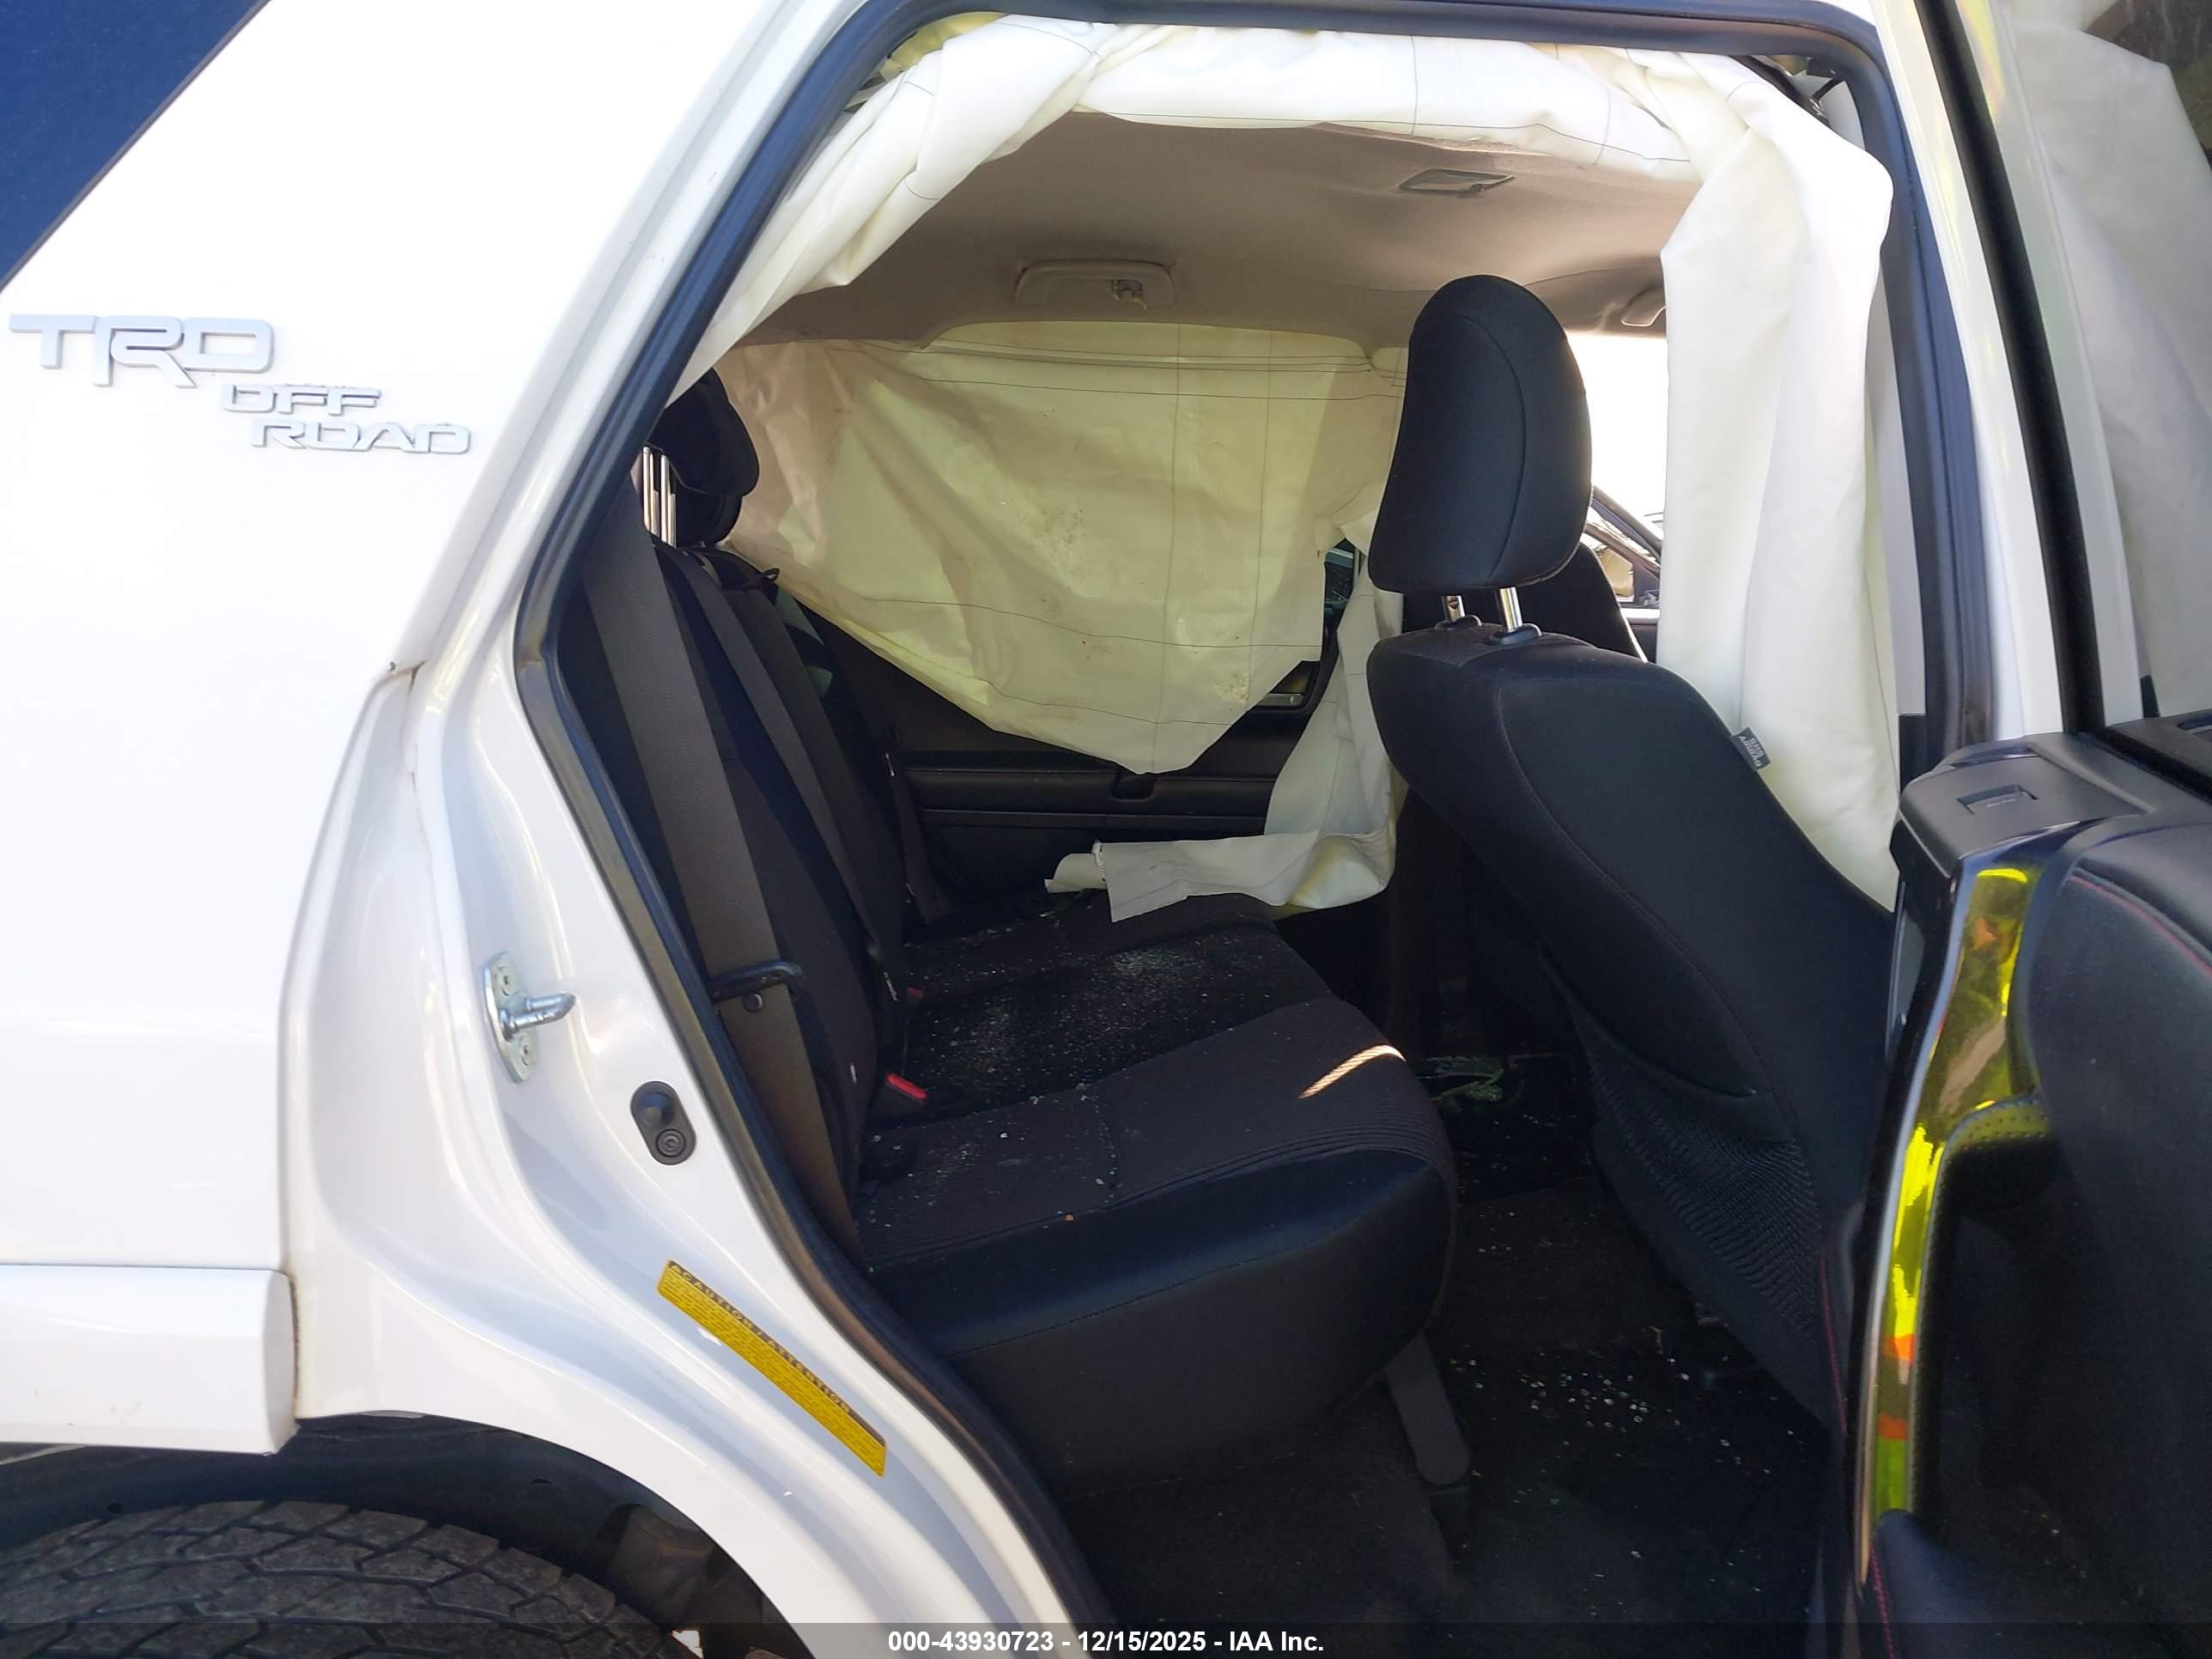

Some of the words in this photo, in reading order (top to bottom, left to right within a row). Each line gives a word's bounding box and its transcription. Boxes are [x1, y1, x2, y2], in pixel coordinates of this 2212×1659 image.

[9, 314, 276, 388] TRD
[222, 383, 381, 415] OFF
[252, 418, 471, 454] ROAD
[681, 1269, 756, 1329] CAUTION
